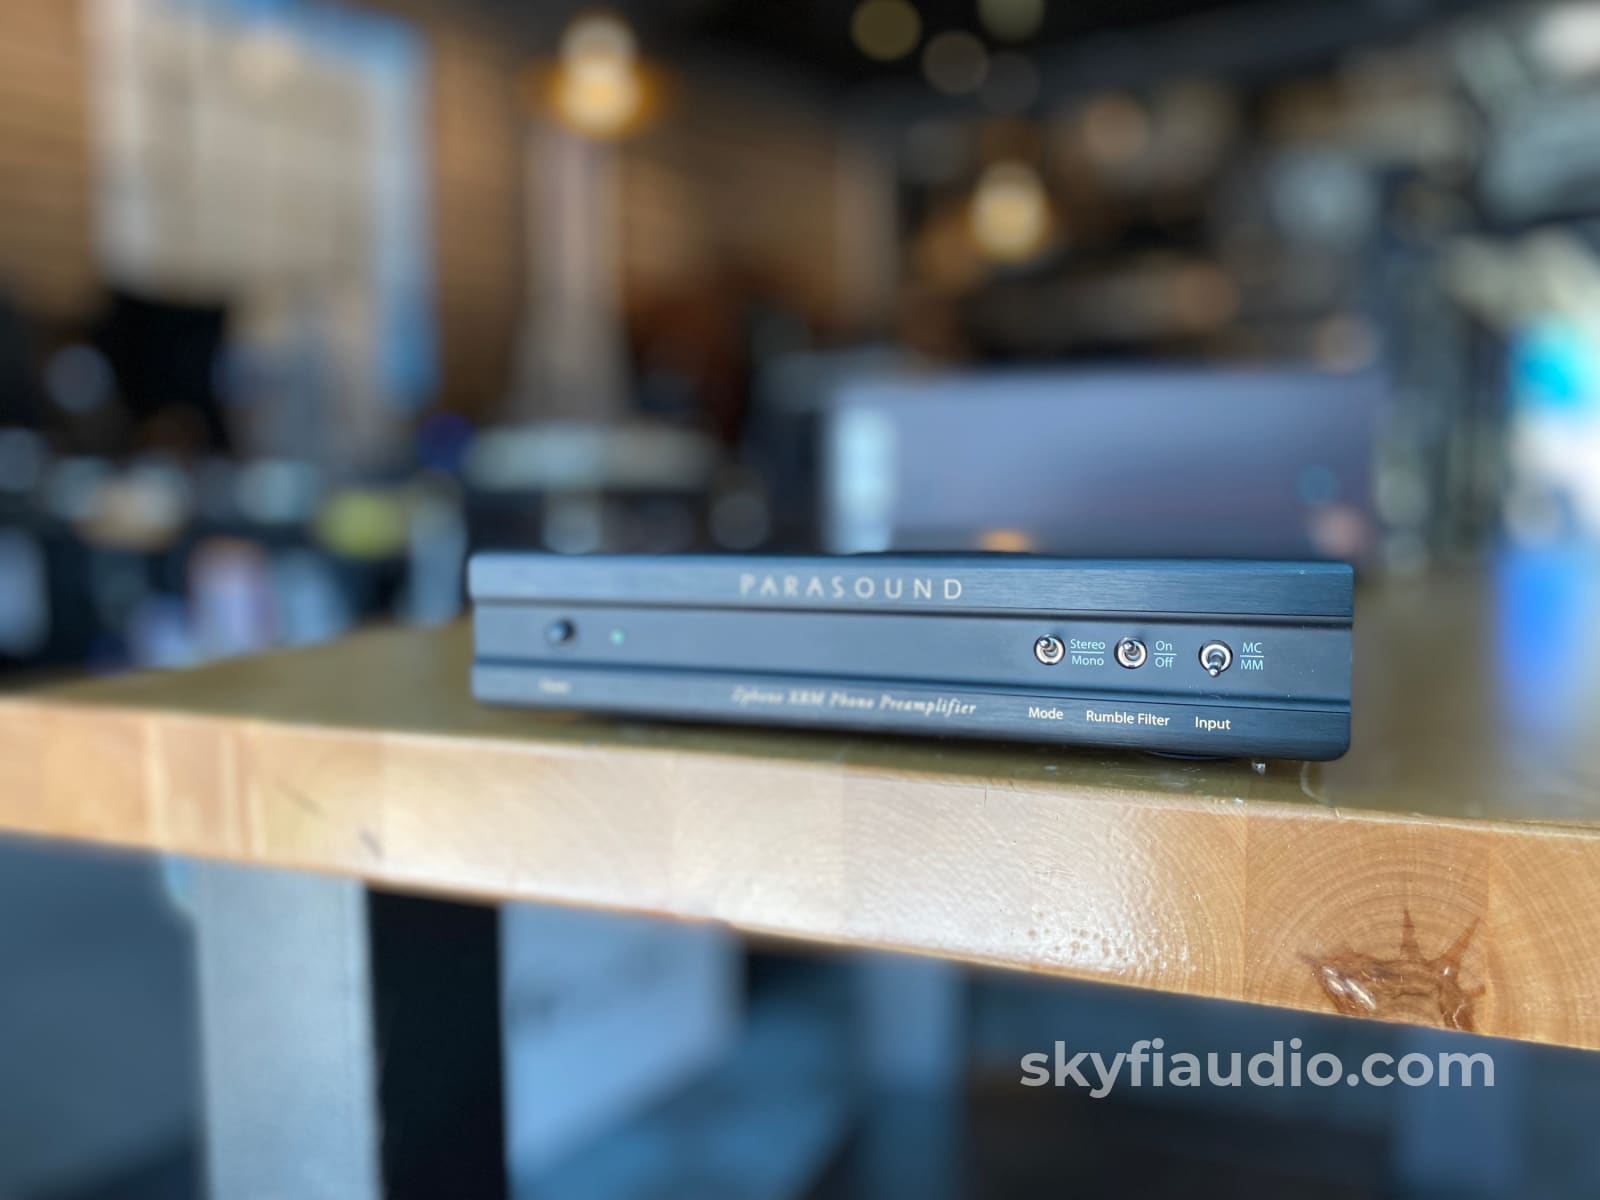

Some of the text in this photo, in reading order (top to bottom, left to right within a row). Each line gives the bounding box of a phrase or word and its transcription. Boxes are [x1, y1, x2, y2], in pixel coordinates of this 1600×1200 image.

[739, 573, 962, 600] PARASOUND
[1070, 638, 1106, 651] Stereo
[1155, 640, 1173, 652] On
[1242, 642, 1263, 654] MC
[1071, 656, 1105, 667] Mono
[1155, 656, 1174, 669] Off
[1240, 659, 1264, 671] MM
[829, 690, 874, 709] Phono
[879, 693, 977, 717] Preamplifier
[1028, 706, 1065, 720] Mode
[1086, 710, 1170, 727] Rumble Filter
[1195, 716, 1231, 732] Input
